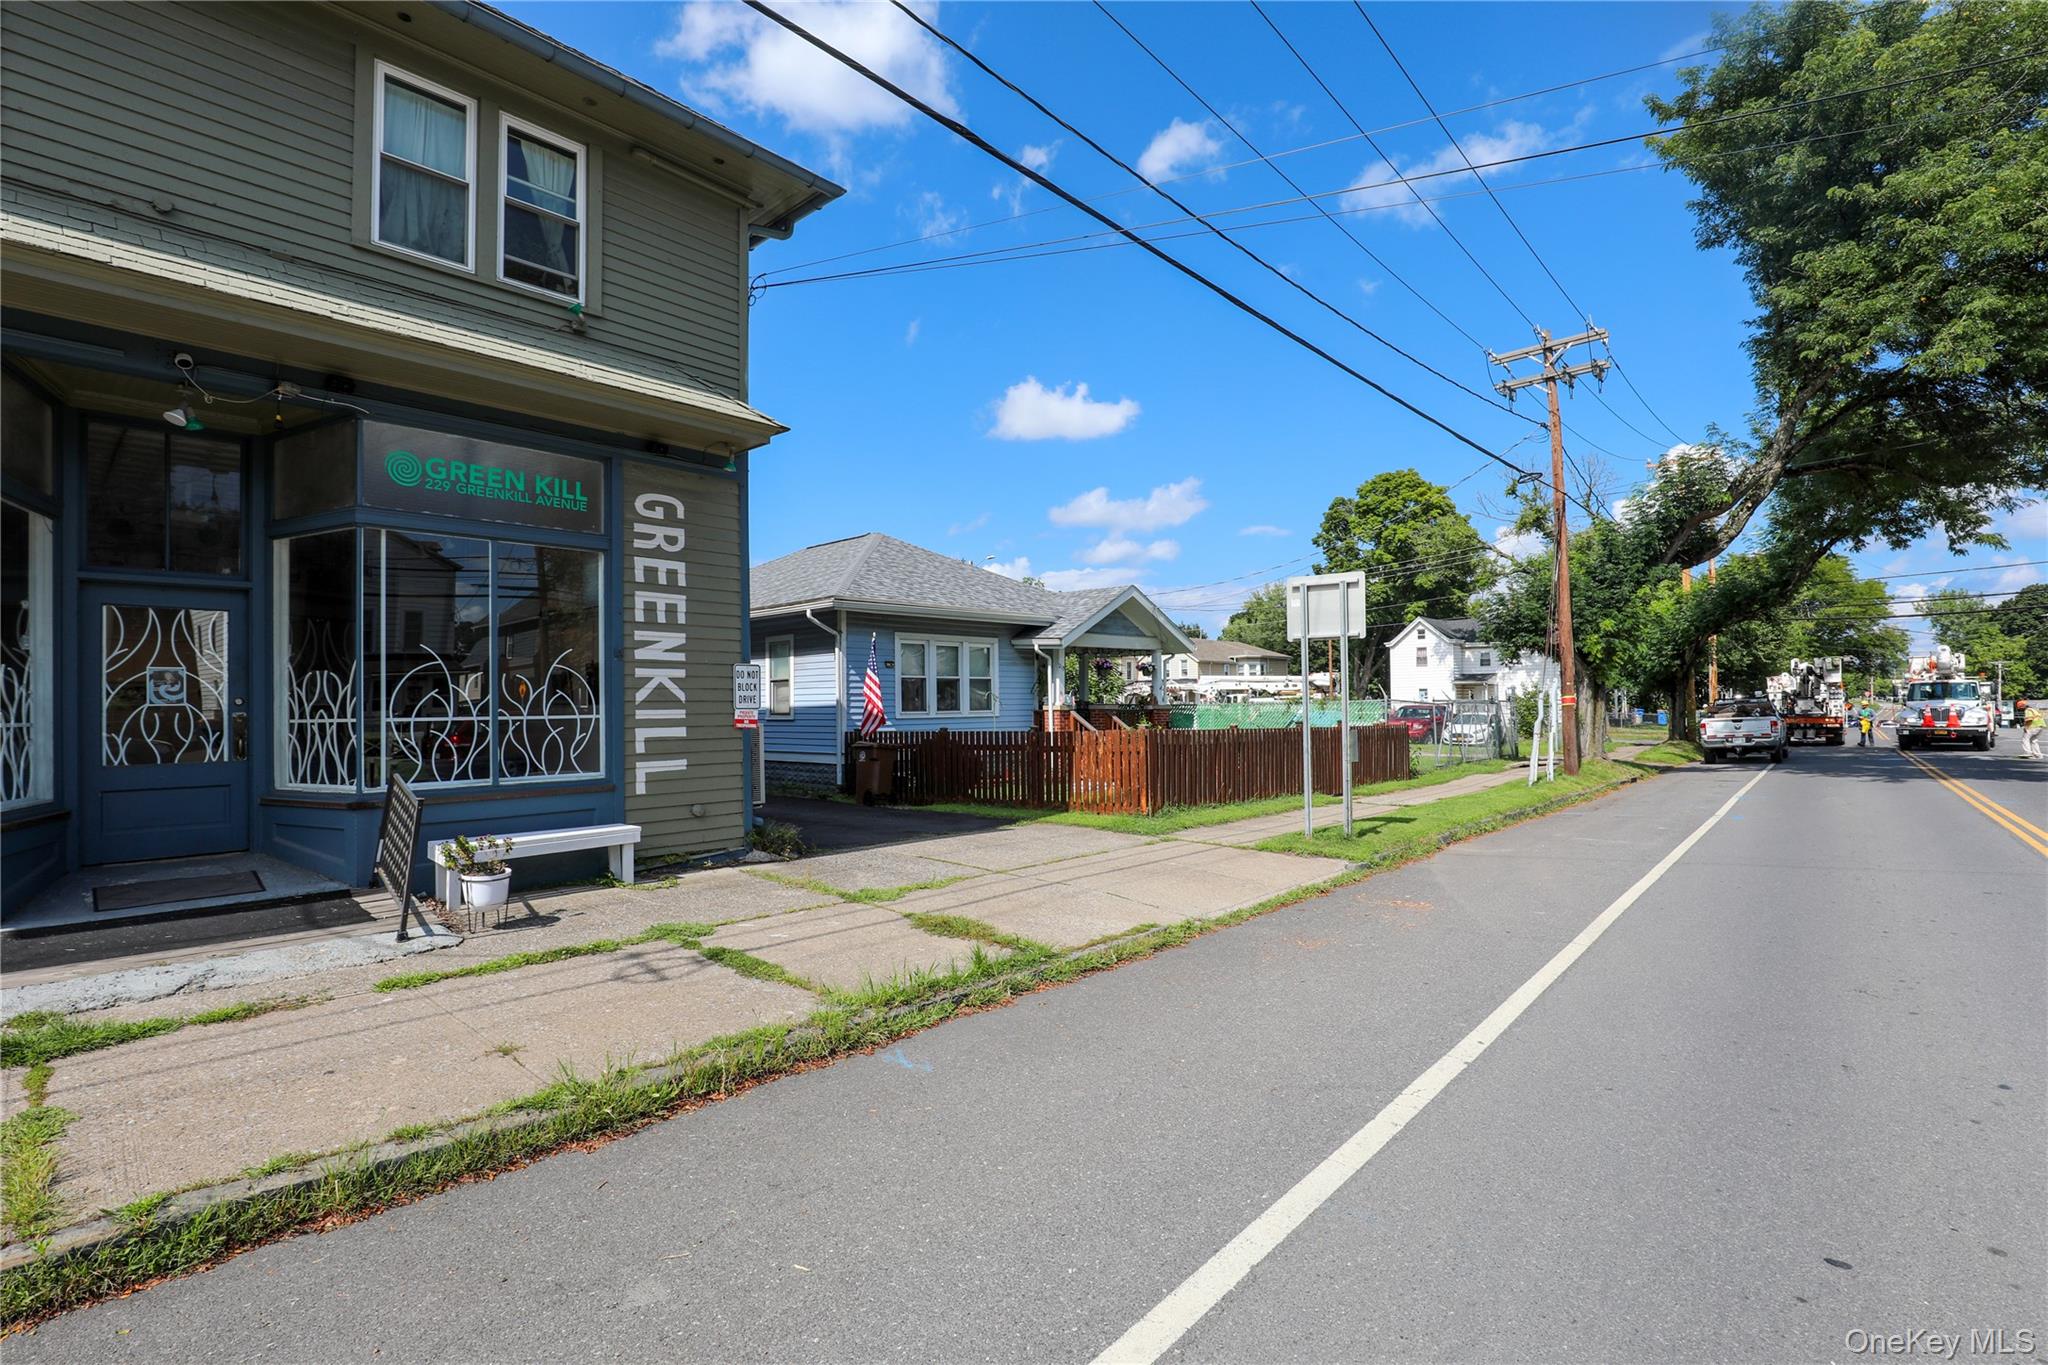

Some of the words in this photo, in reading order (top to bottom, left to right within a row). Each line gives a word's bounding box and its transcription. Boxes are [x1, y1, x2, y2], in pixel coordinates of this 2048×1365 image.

[424, 478, 450, 492] 229
[456, 482, 532, 503] GREENKILL
[536, 495, 588, 512] AVENUE
[425, 457, 526, 490] GREEN
[535, 475, 588, 500] KILL
[633, 494, 688, 795] GREENKILL
[736, 671, 745, 679] DO
[747, 671, 758, 679] NOT
[737, 683, 757, 691] BLOCK
